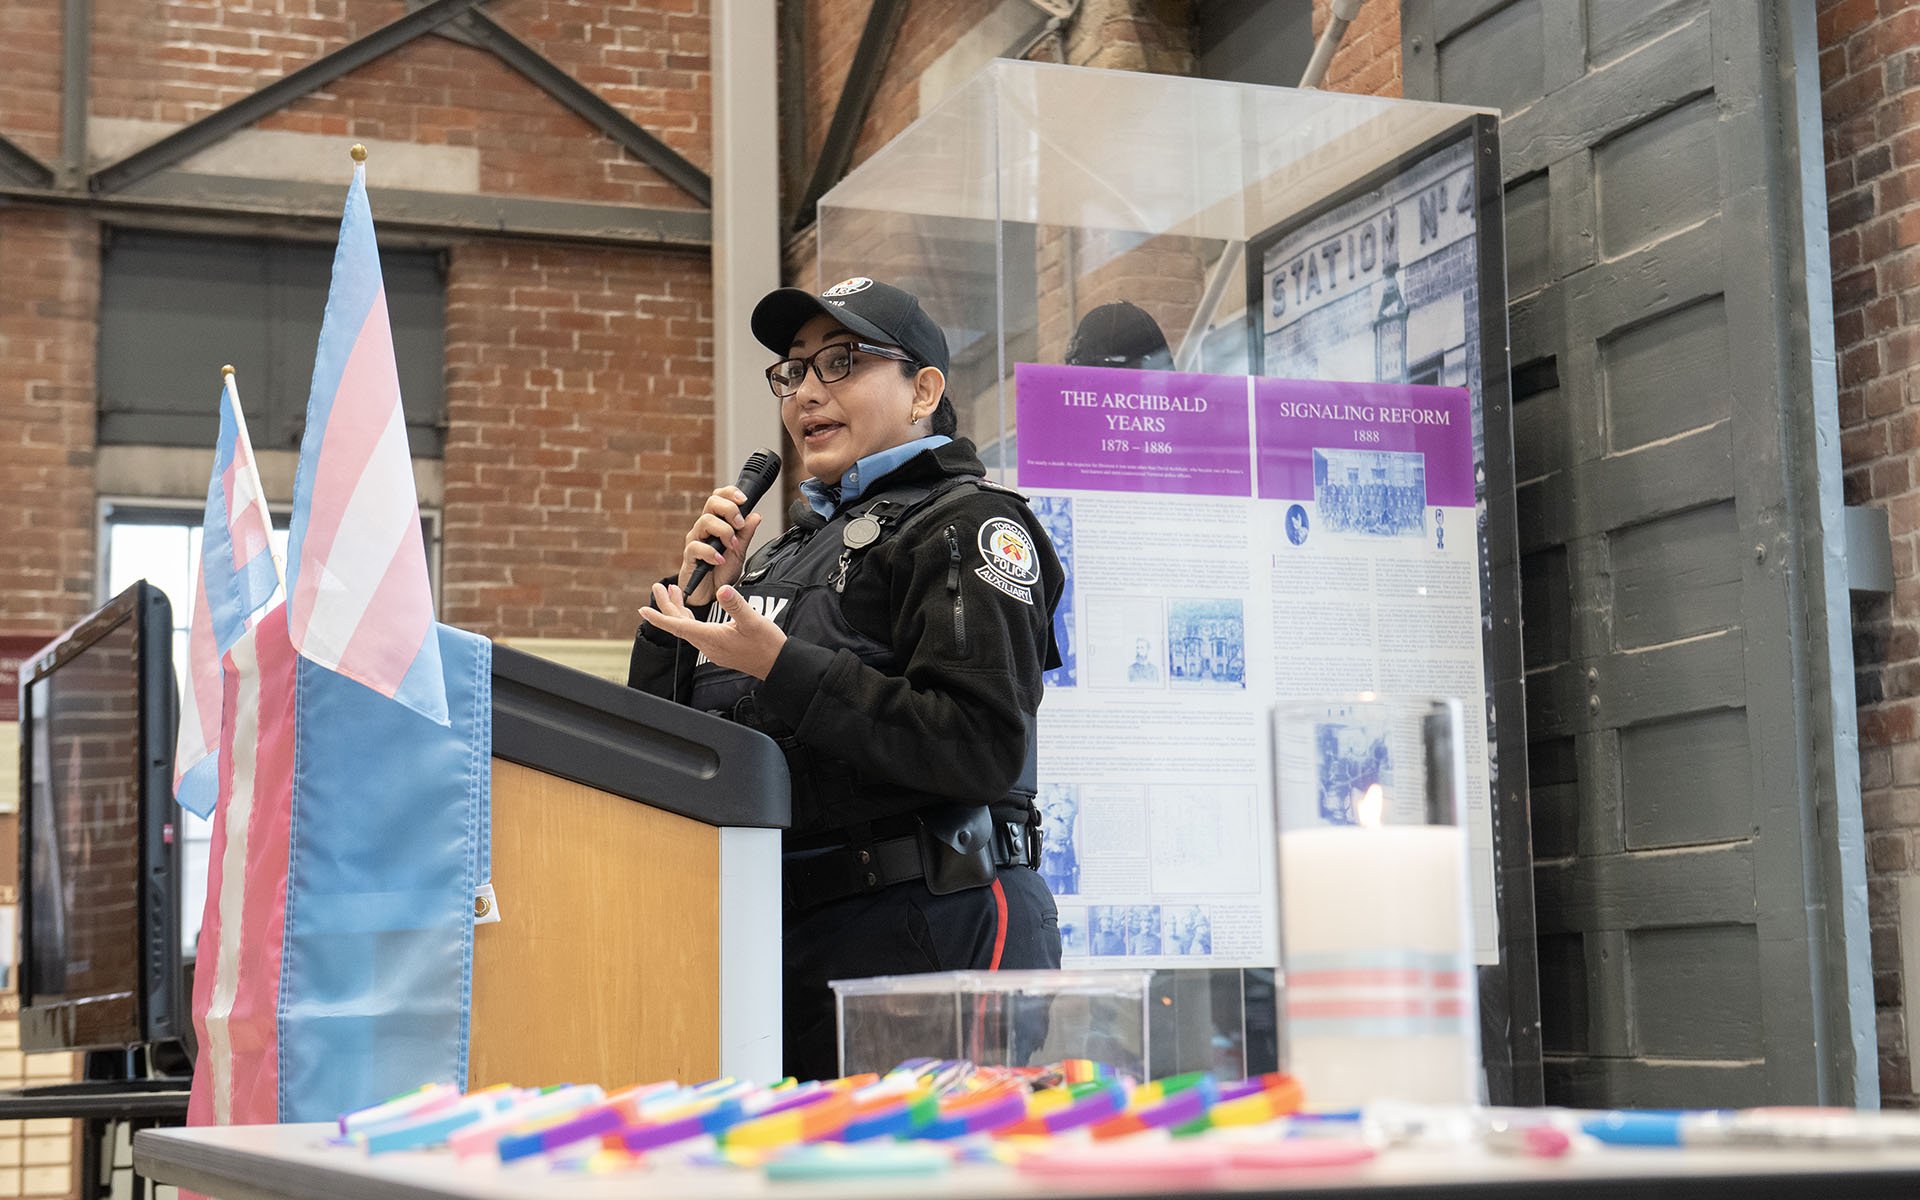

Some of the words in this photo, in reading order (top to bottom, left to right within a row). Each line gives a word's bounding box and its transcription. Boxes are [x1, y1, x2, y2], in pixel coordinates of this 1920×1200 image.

[1271, 209, 1399, 319] STATION
[1457, 169, 1476, 219] 4
[1061, 390, 1098, 408] THE
[1101, 393, 1208, 413] ARCHIBALD
[1105, 415, 1166, 433] YEARS
[1280, 402, 1375, 422] SIGNALING
[1379, 407, 1451, 425] REFORM
[1101, 439, 1130, 452] 1878
[1144, 441, 1173, 454] 1886
[1353, 430, 1380, 443] 1888
[991, 522, 1032, 551] TORONTO
[993, 555, 1027, 579] POLICE
[980, 570, 1029, 600] AUXILIARY
